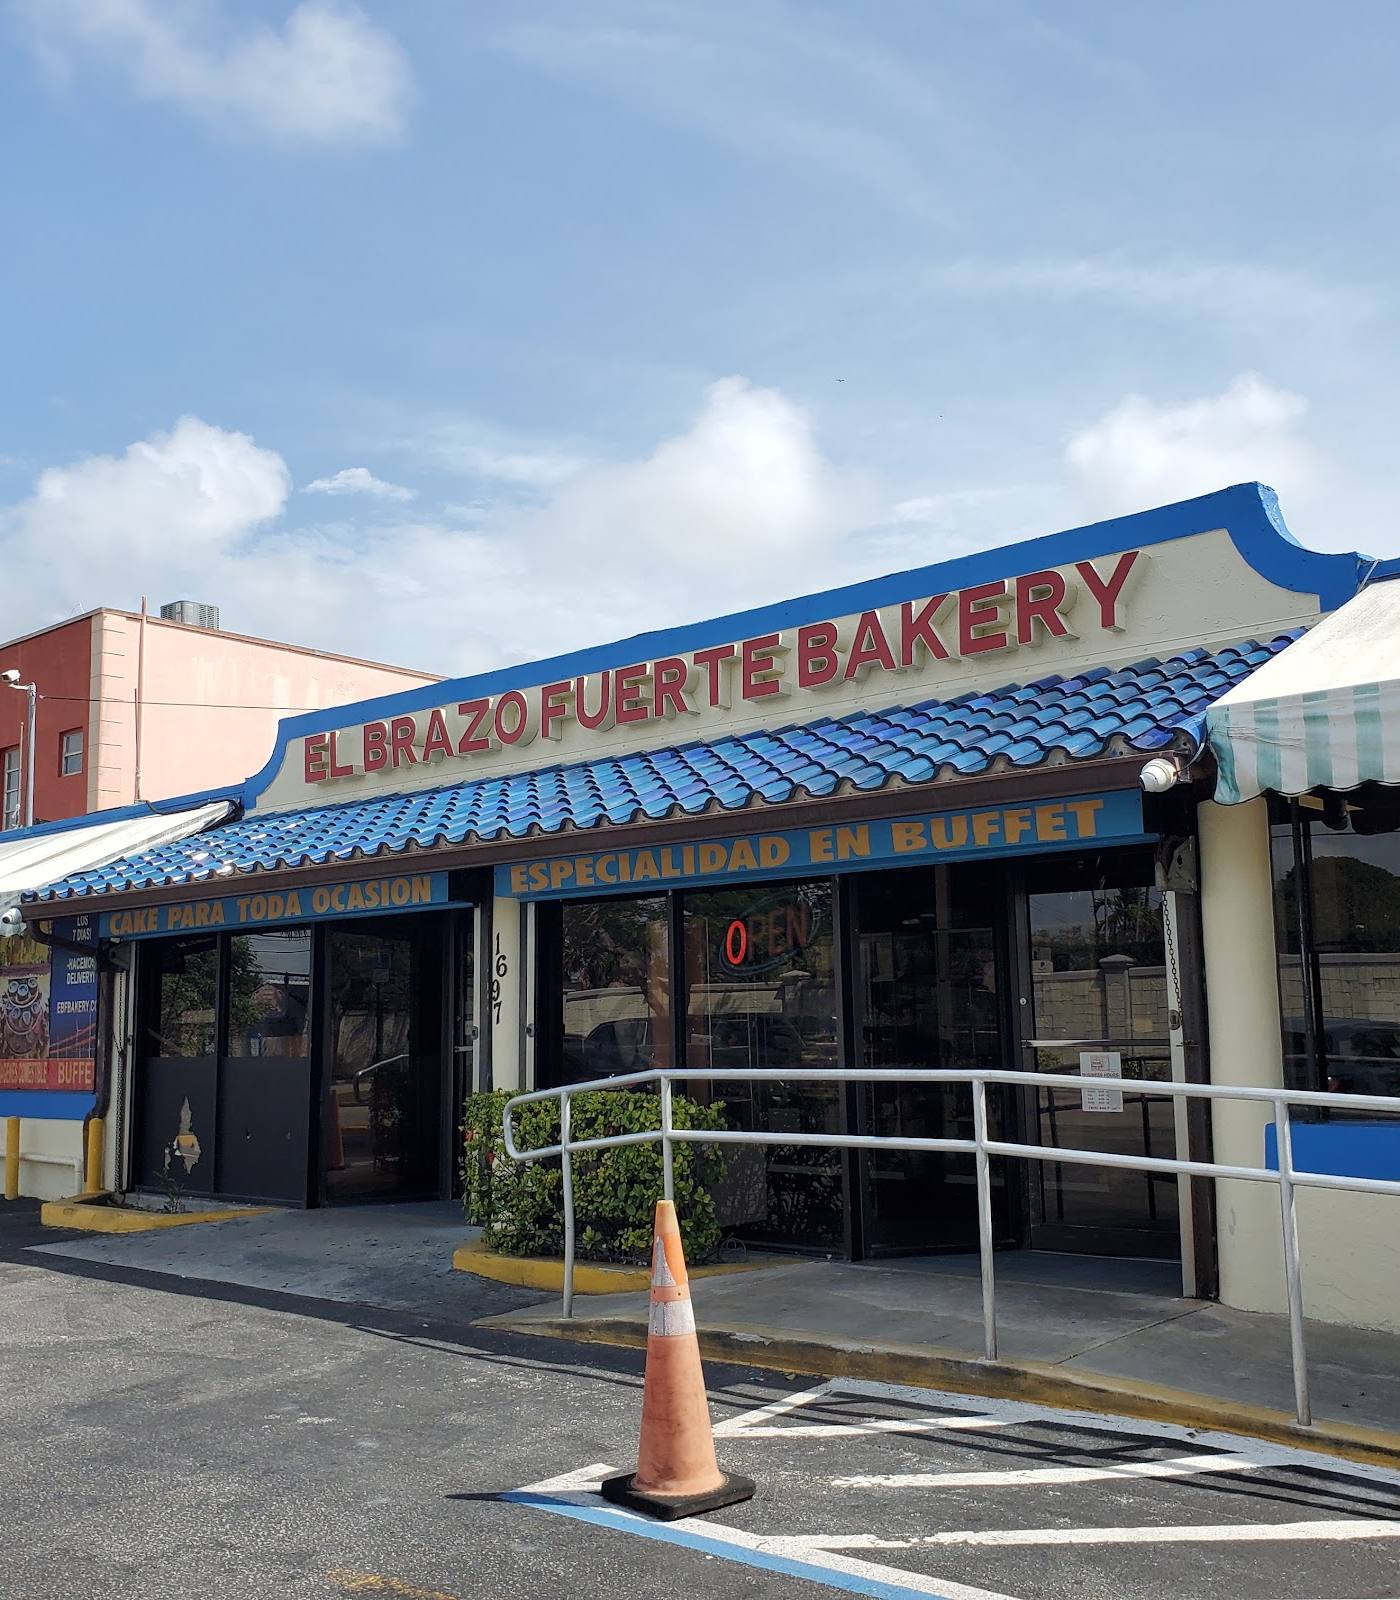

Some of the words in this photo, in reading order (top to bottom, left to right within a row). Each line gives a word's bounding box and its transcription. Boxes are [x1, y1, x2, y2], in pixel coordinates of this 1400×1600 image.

[304, 731, 354, 784] EL
[363, 690, 529, 773] BRAZO
[541, 633, 782, 740] FUERTE
[798, 550, 1141, 688] BAKERY
[510, 836, 791, 894] ESPECIALIDAD
[809, 824, 871, 863] EN
[891, 800, 1105, 853] BUFFET
[76, 915, 89, 926] LOS
[109, 909, 158, 937] CAKE
[167, 901, 225, 930] PARA
[238, 892, 302, 921] TODA
[312, 875, 433, 913] OCASION
[726, 902, 809, 985] OPEN
[492, 932, 508, 1024] 1697
